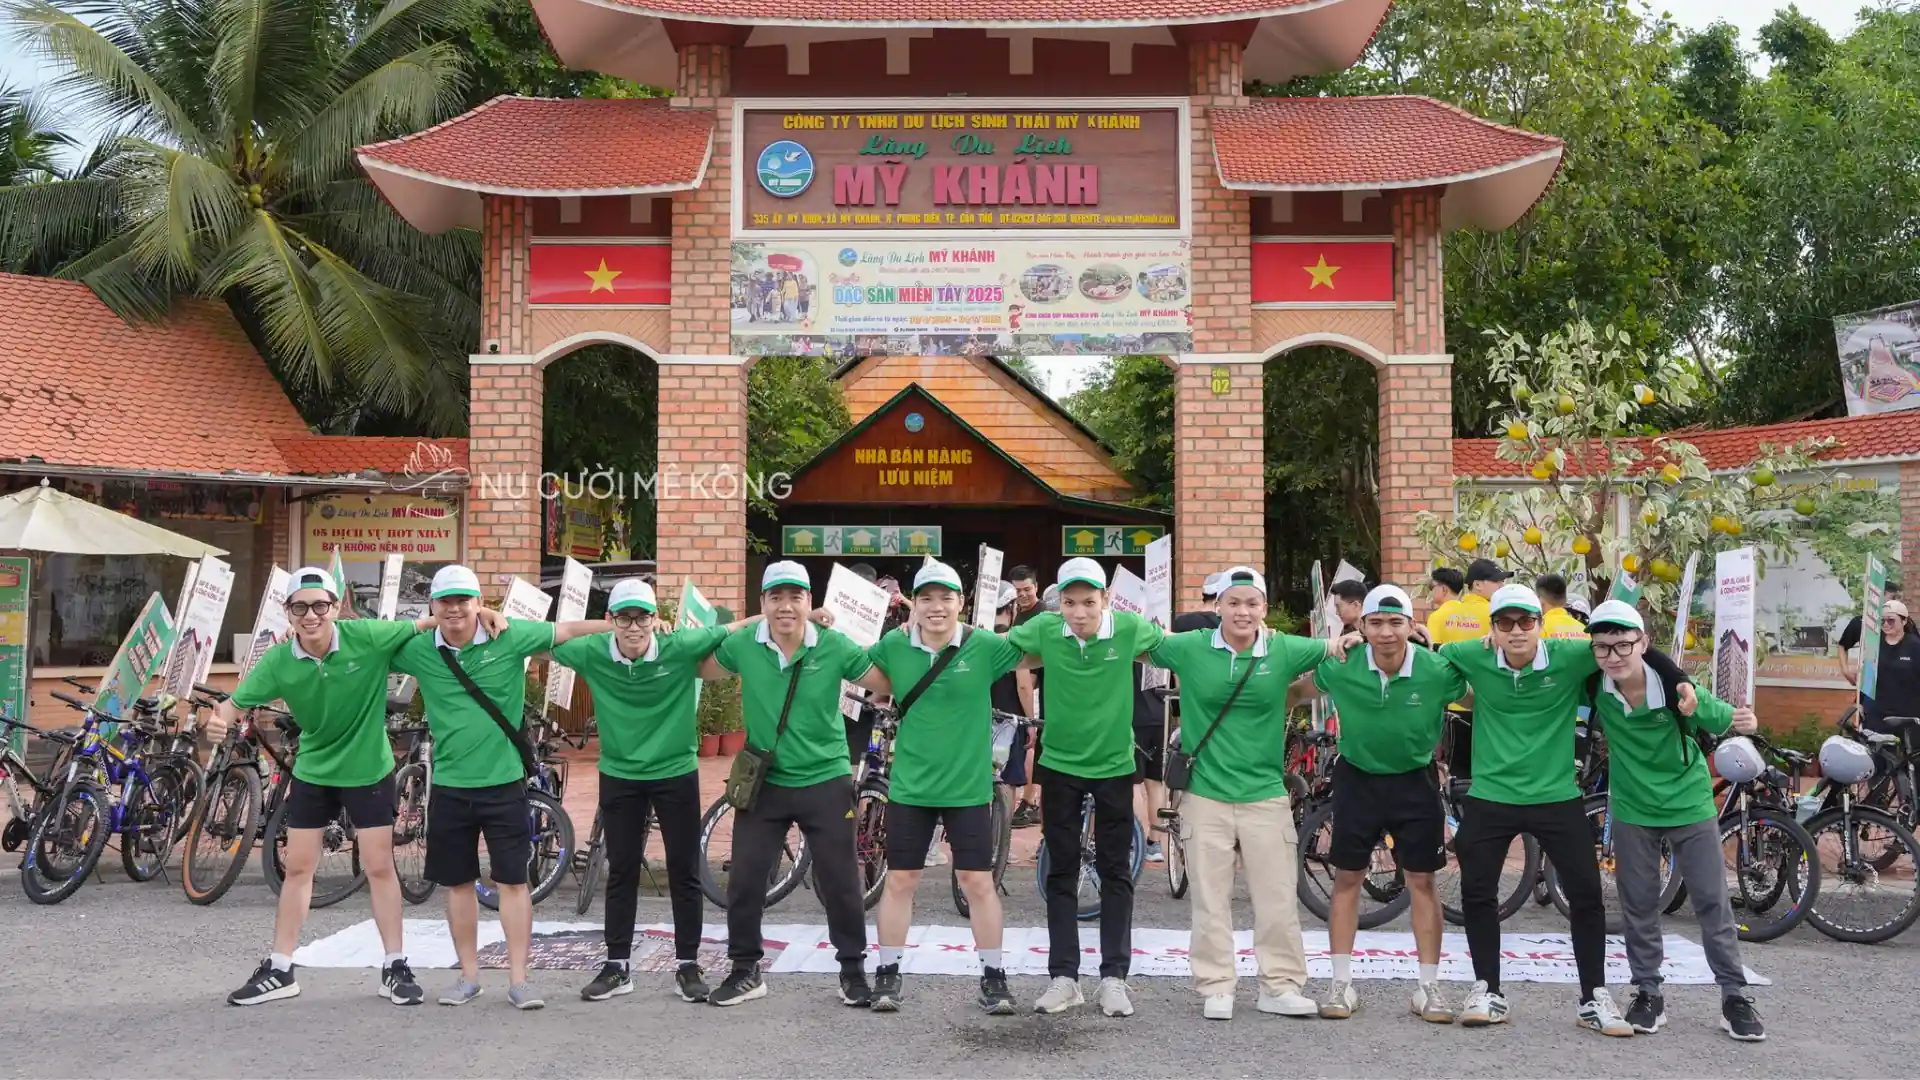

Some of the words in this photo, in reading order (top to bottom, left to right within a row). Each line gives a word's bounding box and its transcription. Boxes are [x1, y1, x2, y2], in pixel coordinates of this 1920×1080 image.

[783, 113, 824, 129] CÔNG
[831, 115, 850, 129] TY
[856, 115, 898, 129] TNHH
[904, 115, 924, 129] DU
[931, 114, 965, 131] LỊCH
[971, 114, 1007, 129] SINH
[1013, 113, 1050, 129] THÁI
[1055, 112, 1080, 129] MỸ
[1087, 113, 1140, 129] KHÁNH
[858, 134, 929, 159] Làng
[951, 134, 995, 156] Du
[1013, 132, 1072, 159] Lịch
[834, 159, 909, 206] MỸ
[933, 158, 1098, 206] KHÁNH
[929, 248, 948, 263] MỸ
[952, 248, 995, 263] KHÁNH
[835, 282, 863, 307] ĐẶC
[899, 281, 933, 302] MIỀN
[937, 283, 962, 302] TÂY
[967, 286, 1003, 303] 2025
[1212, 379, 1230, 393] 02
[855, 446, 888, 464] NHÀ
[890, 445, 924, 464] BÁN
[928, 446, 973, 464] HÀNG
[879, 467, 910, 485] LƯU
[913, 467, 953, 489] NIỆM
[312, 528, 328, 537] 05
[331, 528, 363, 540] DỊCH
[368, 528, 384, 540] VỤ
[387, 528, 414, 538] HOT
[417, 525, 452, 538] NHẤT
[344, 539, 377, 552] KHÔNG
[417, 542, 436, 553] QUA
